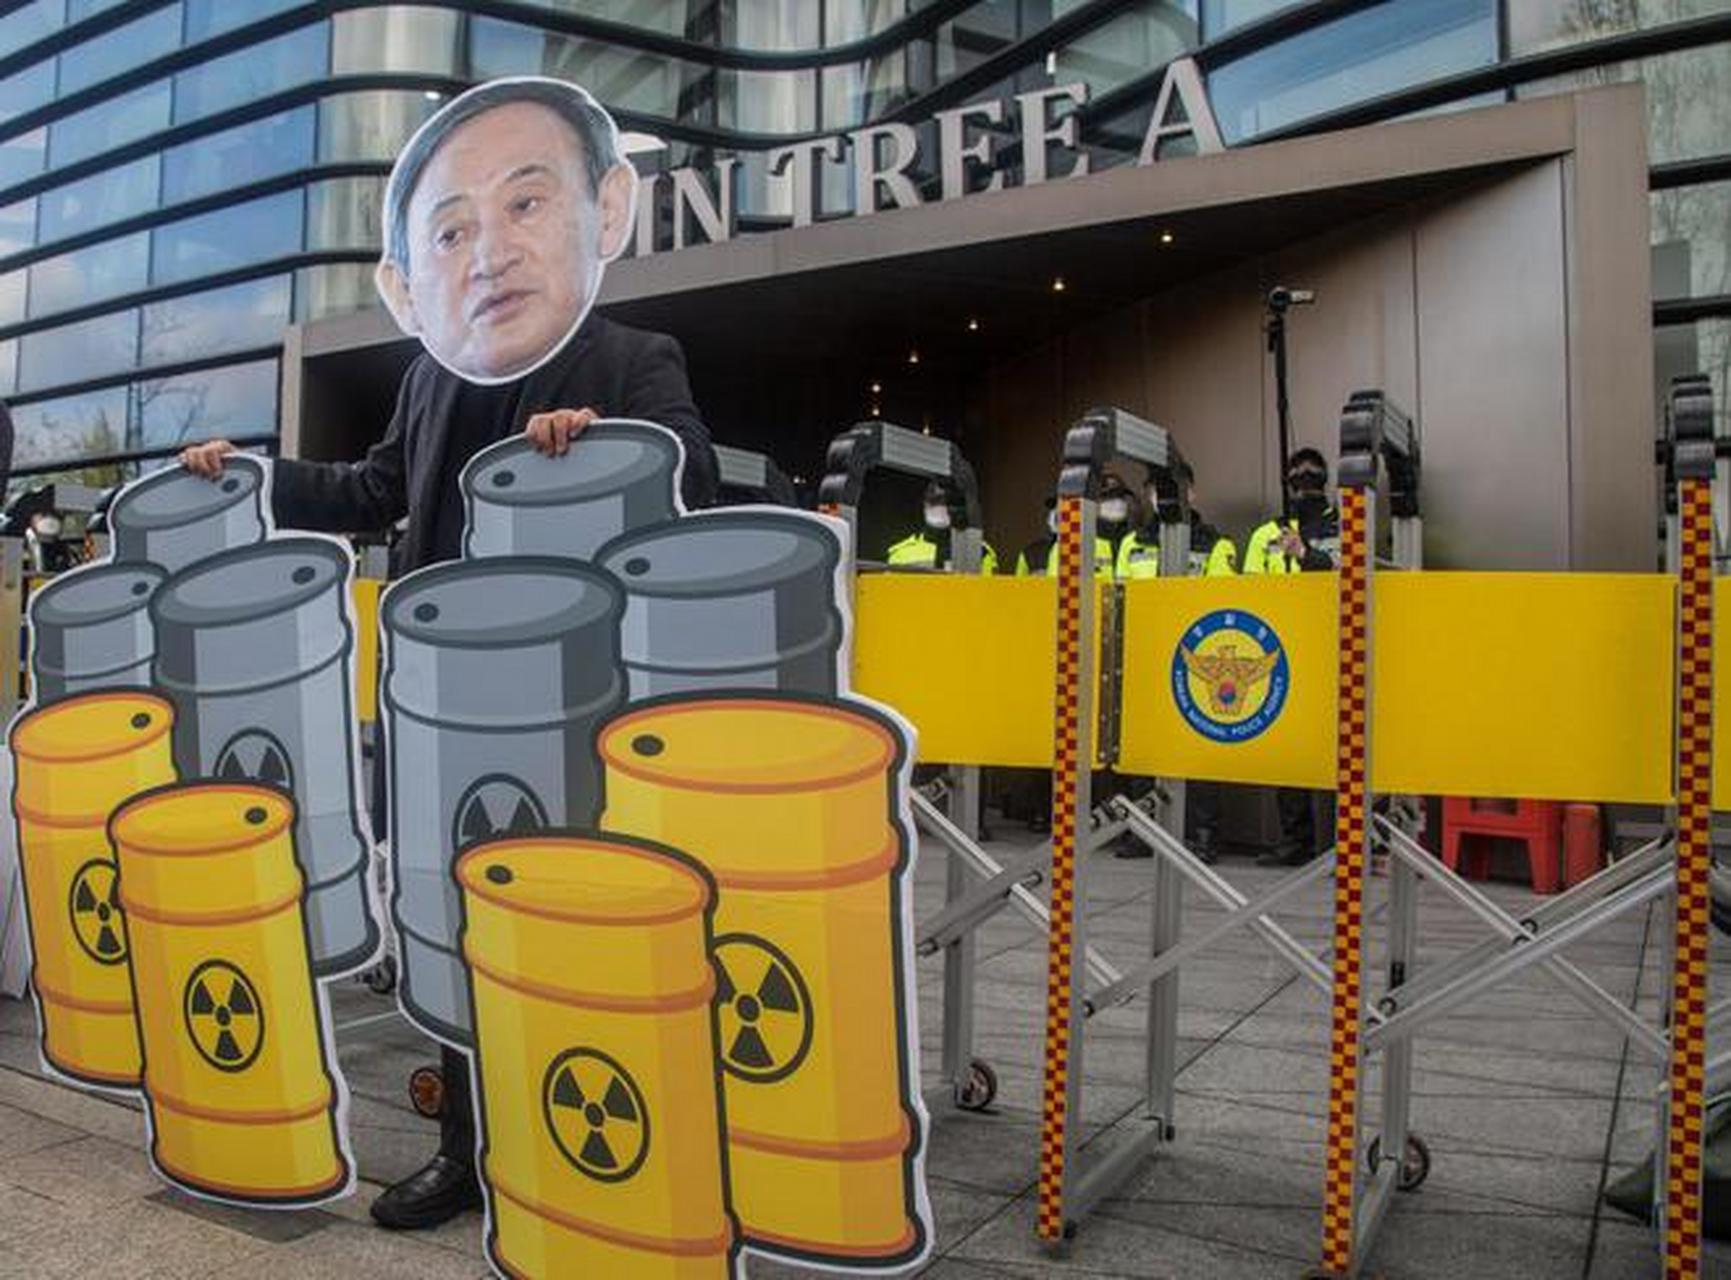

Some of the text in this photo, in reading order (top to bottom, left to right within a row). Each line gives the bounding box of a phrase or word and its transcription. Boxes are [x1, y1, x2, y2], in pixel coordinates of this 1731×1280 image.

[635, 57, 1226, 258] IN TREE A
